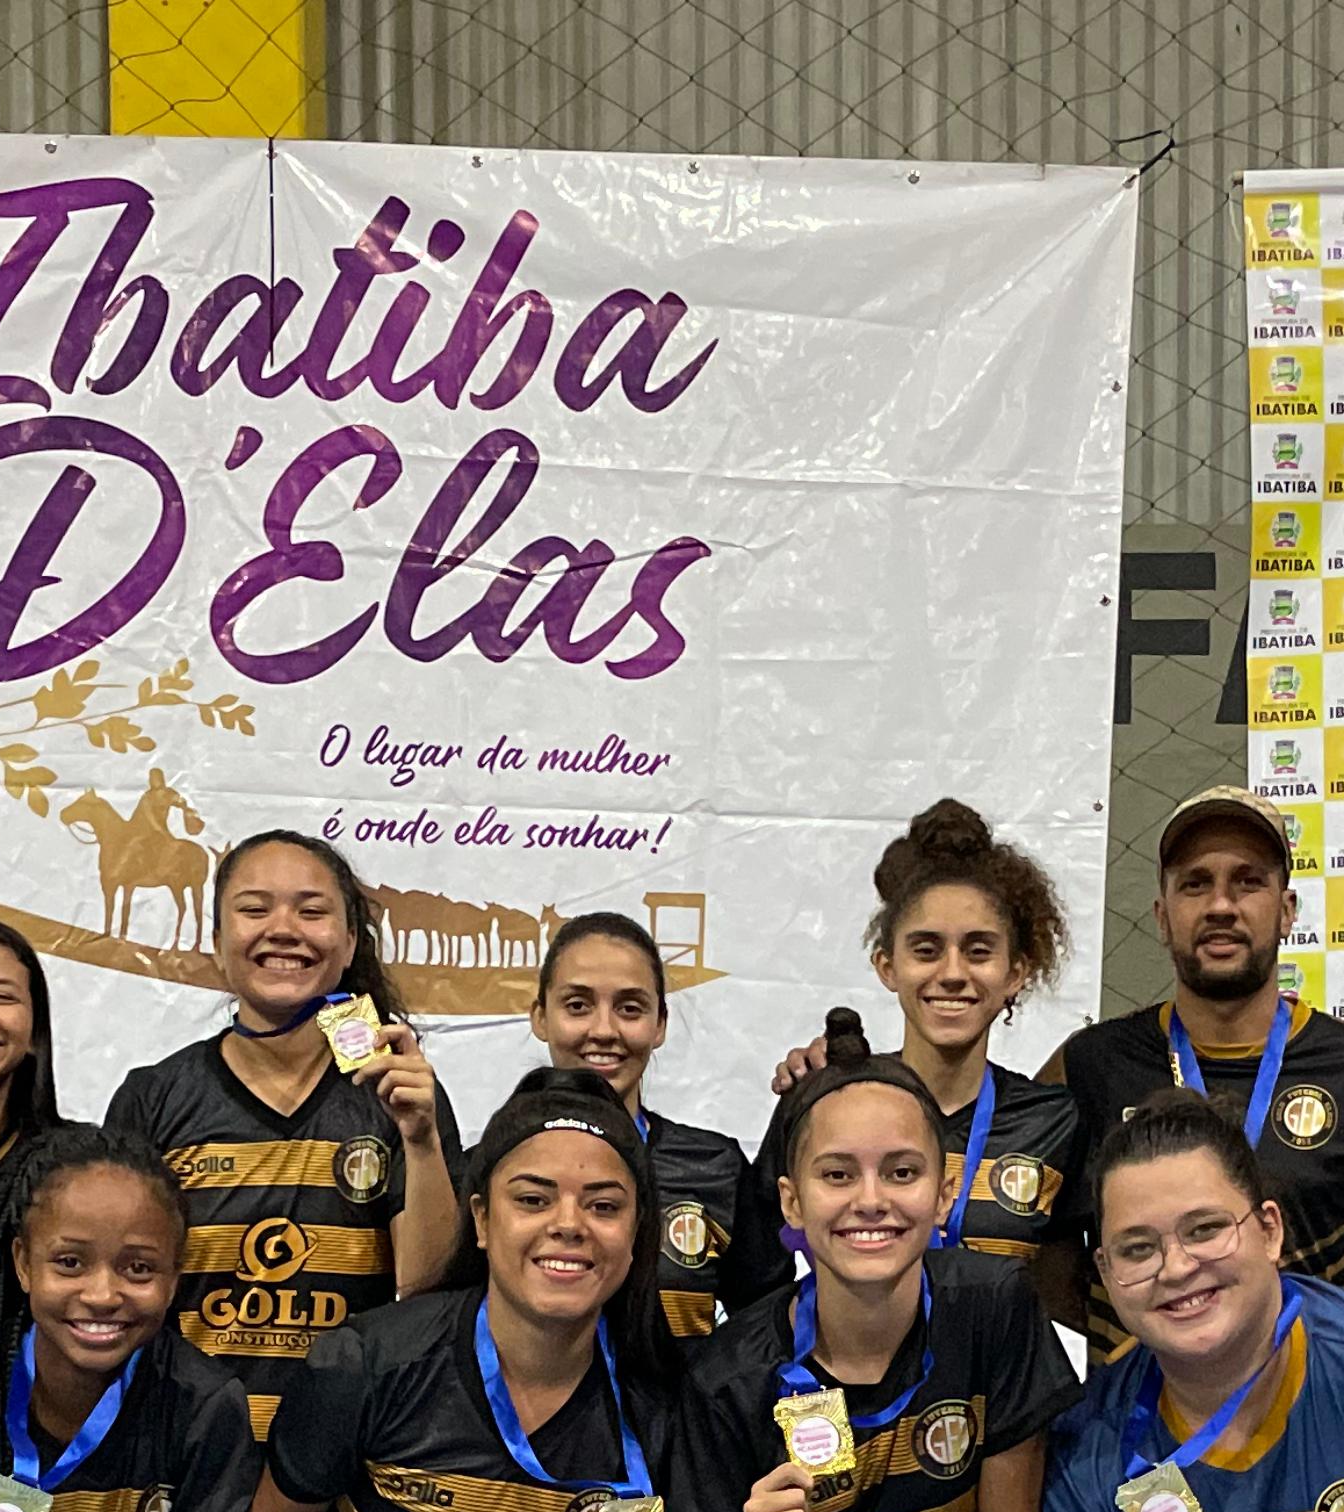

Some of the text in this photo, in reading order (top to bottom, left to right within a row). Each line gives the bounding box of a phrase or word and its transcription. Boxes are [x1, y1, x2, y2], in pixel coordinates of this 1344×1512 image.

[1251, 245, 1315, 263] IBATIBA
[1253, 324, 1317, 340] IBATIBA
[1255, 402, 1319, 417] IBATIBA
[1257, 480, 1318, 494] IBATIBA
[1255, 558, 1316, 573] IBATIBA
[1252, 633, 1317, 650] IBATIBA
[1253, 708, 1317, 724] IBATIBA
[319, 723, 671, 787] O lugar da mulher
[1253, 782, 1318, 799] IBATIBA
[321, 806, 674, 855] é onde ela sonhar!
[201, 1287, 349, 1329] GOLD
